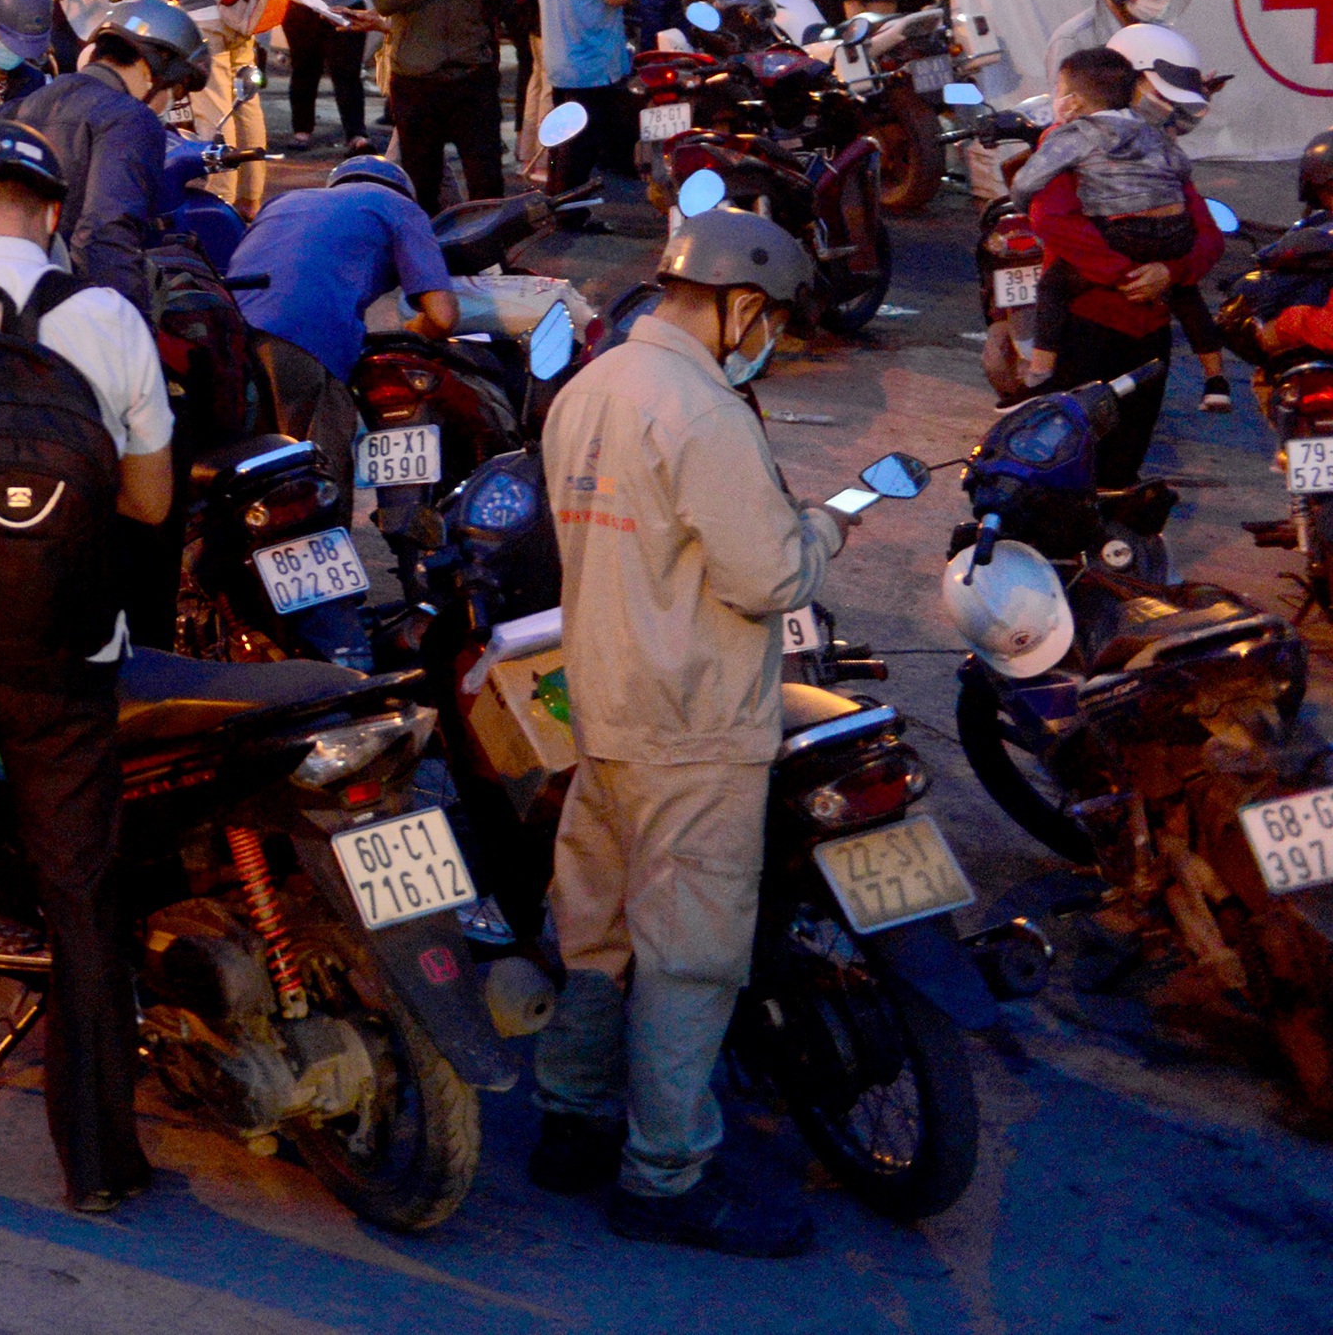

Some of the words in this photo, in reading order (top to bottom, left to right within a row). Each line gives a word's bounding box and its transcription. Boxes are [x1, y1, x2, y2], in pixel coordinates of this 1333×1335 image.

[368, 430, 425, 458] 60-X1
[368, 454, 427, 482] 8590
[271, 536, 339, 575] 86-B8
[275, 561, 361, 606] 022.85
[354, 820, 437, 873] 60-C1
[359, 859, 467, 920] 716.12
